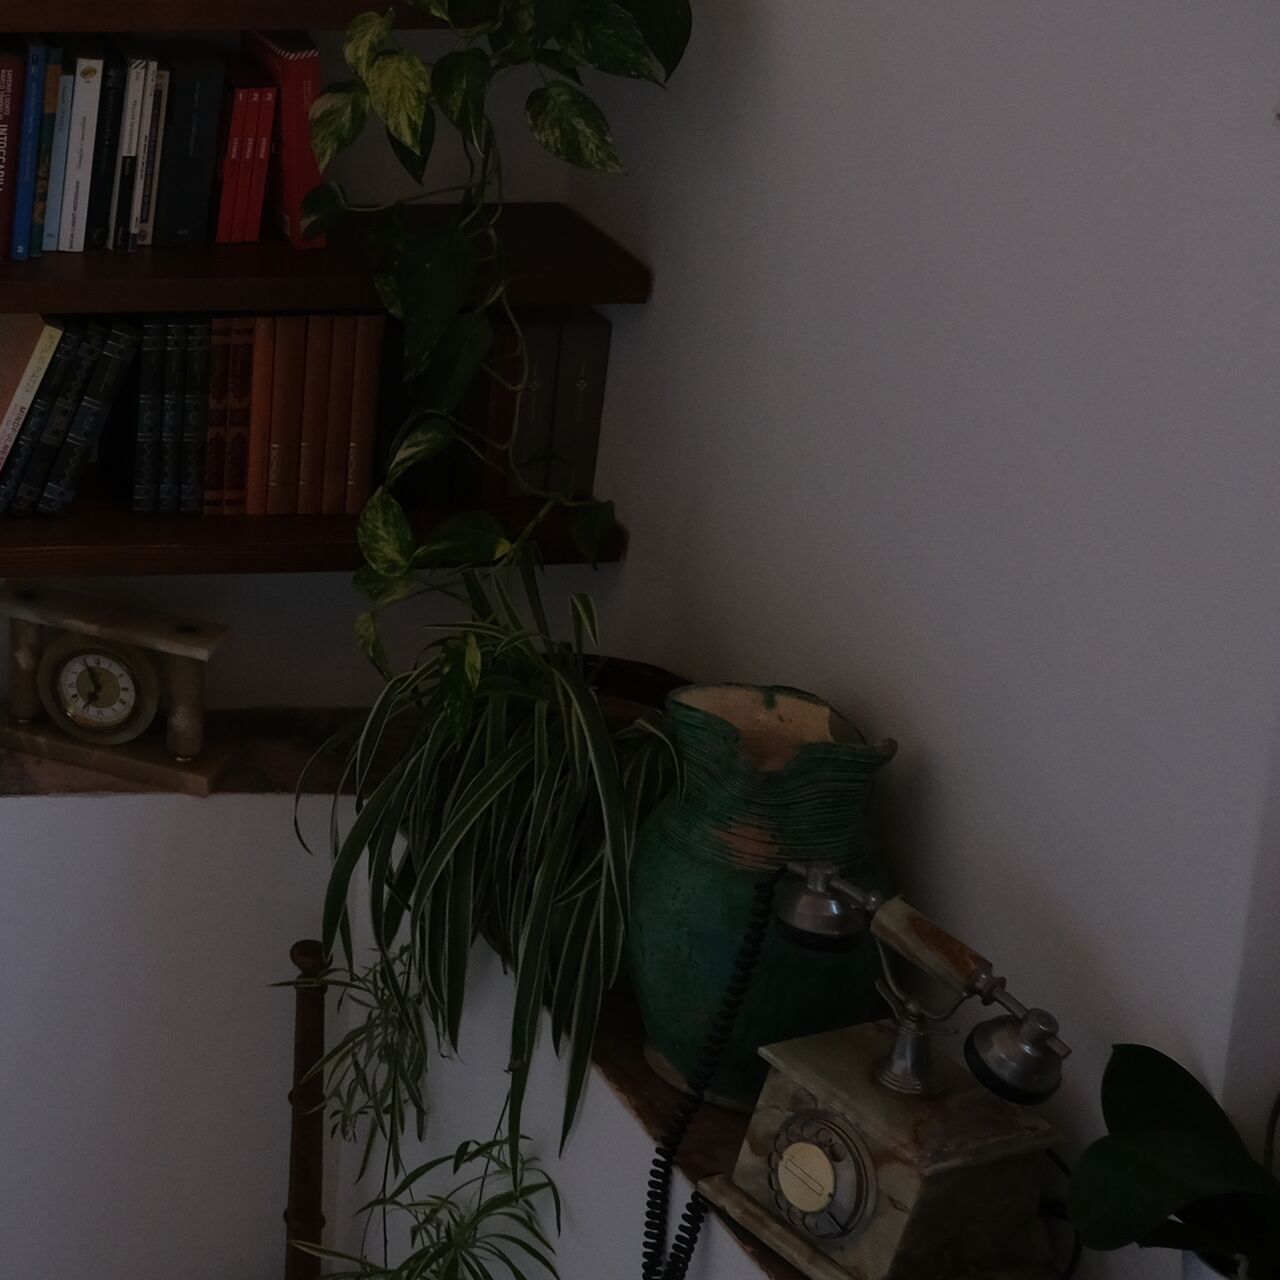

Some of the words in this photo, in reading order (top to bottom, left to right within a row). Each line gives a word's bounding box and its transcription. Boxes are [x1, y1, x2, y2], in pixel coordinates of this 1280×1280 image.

[238, 92, 242, 100] 1
[252, 92, 258, 102] 2
[265, 92, 272, 101] 3
